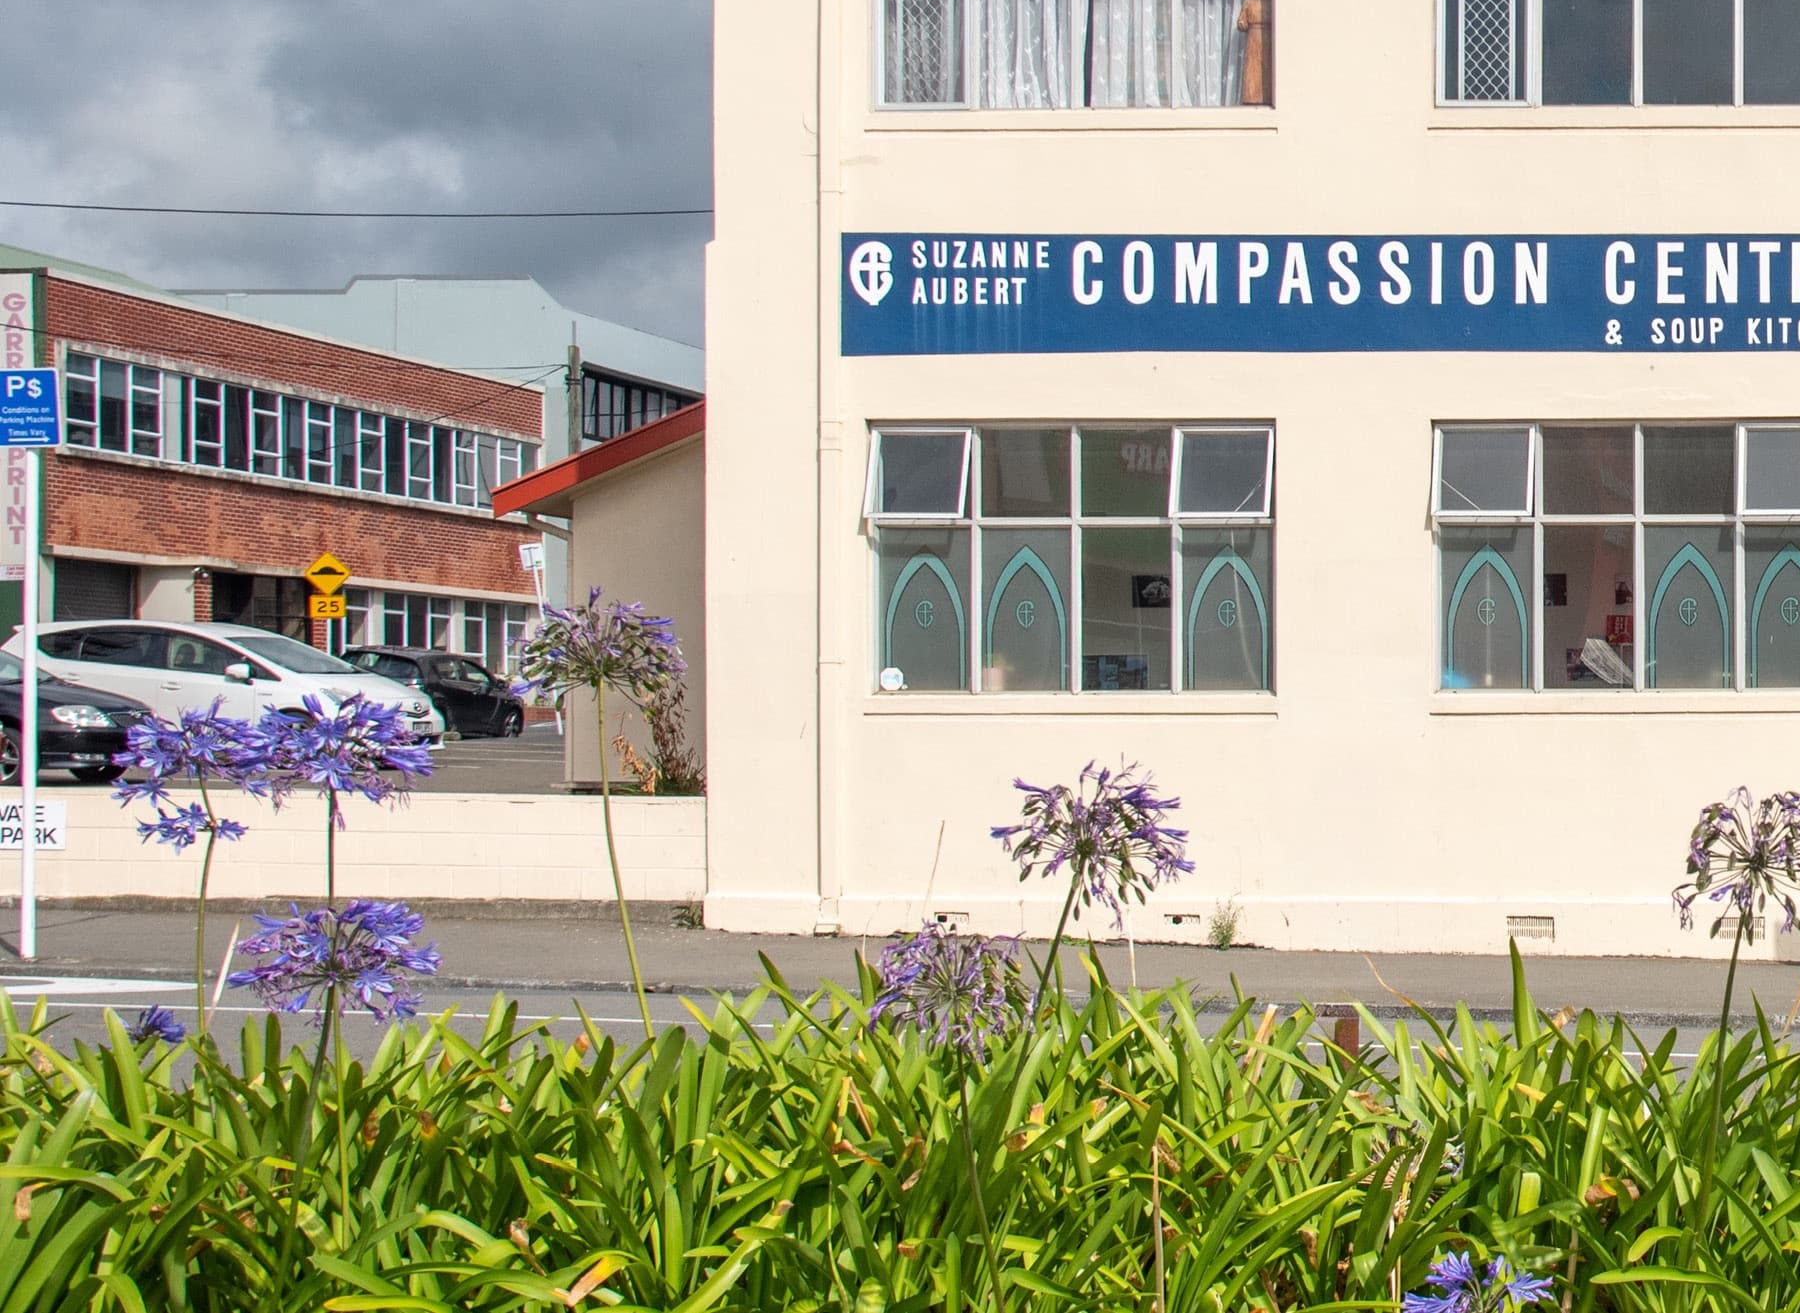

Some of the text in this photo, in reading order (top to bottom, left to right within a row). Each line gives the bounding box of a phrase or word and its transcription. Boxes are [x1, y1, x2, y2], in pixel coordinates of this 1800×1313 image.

[912, 240, 1050, 269] SUZANNE
[1072, 240, 1549, 306] COMPASSION
[912, 277, 1027, 305] AUBERT
[3, 293, 26, 369] GARR
[1604, 319, 1624, 345] &
[1650, 317, 1725, 345] SOUP
[2, 406, 39, 414] Conditions
[8, 428, 46, 437] Times Vary
[7, 448, 26, 544] PRINT
[317, 601, 340, 613] 25
[0, 805, 45, 822] VAE
[1, 827, 57, 844] PARK
